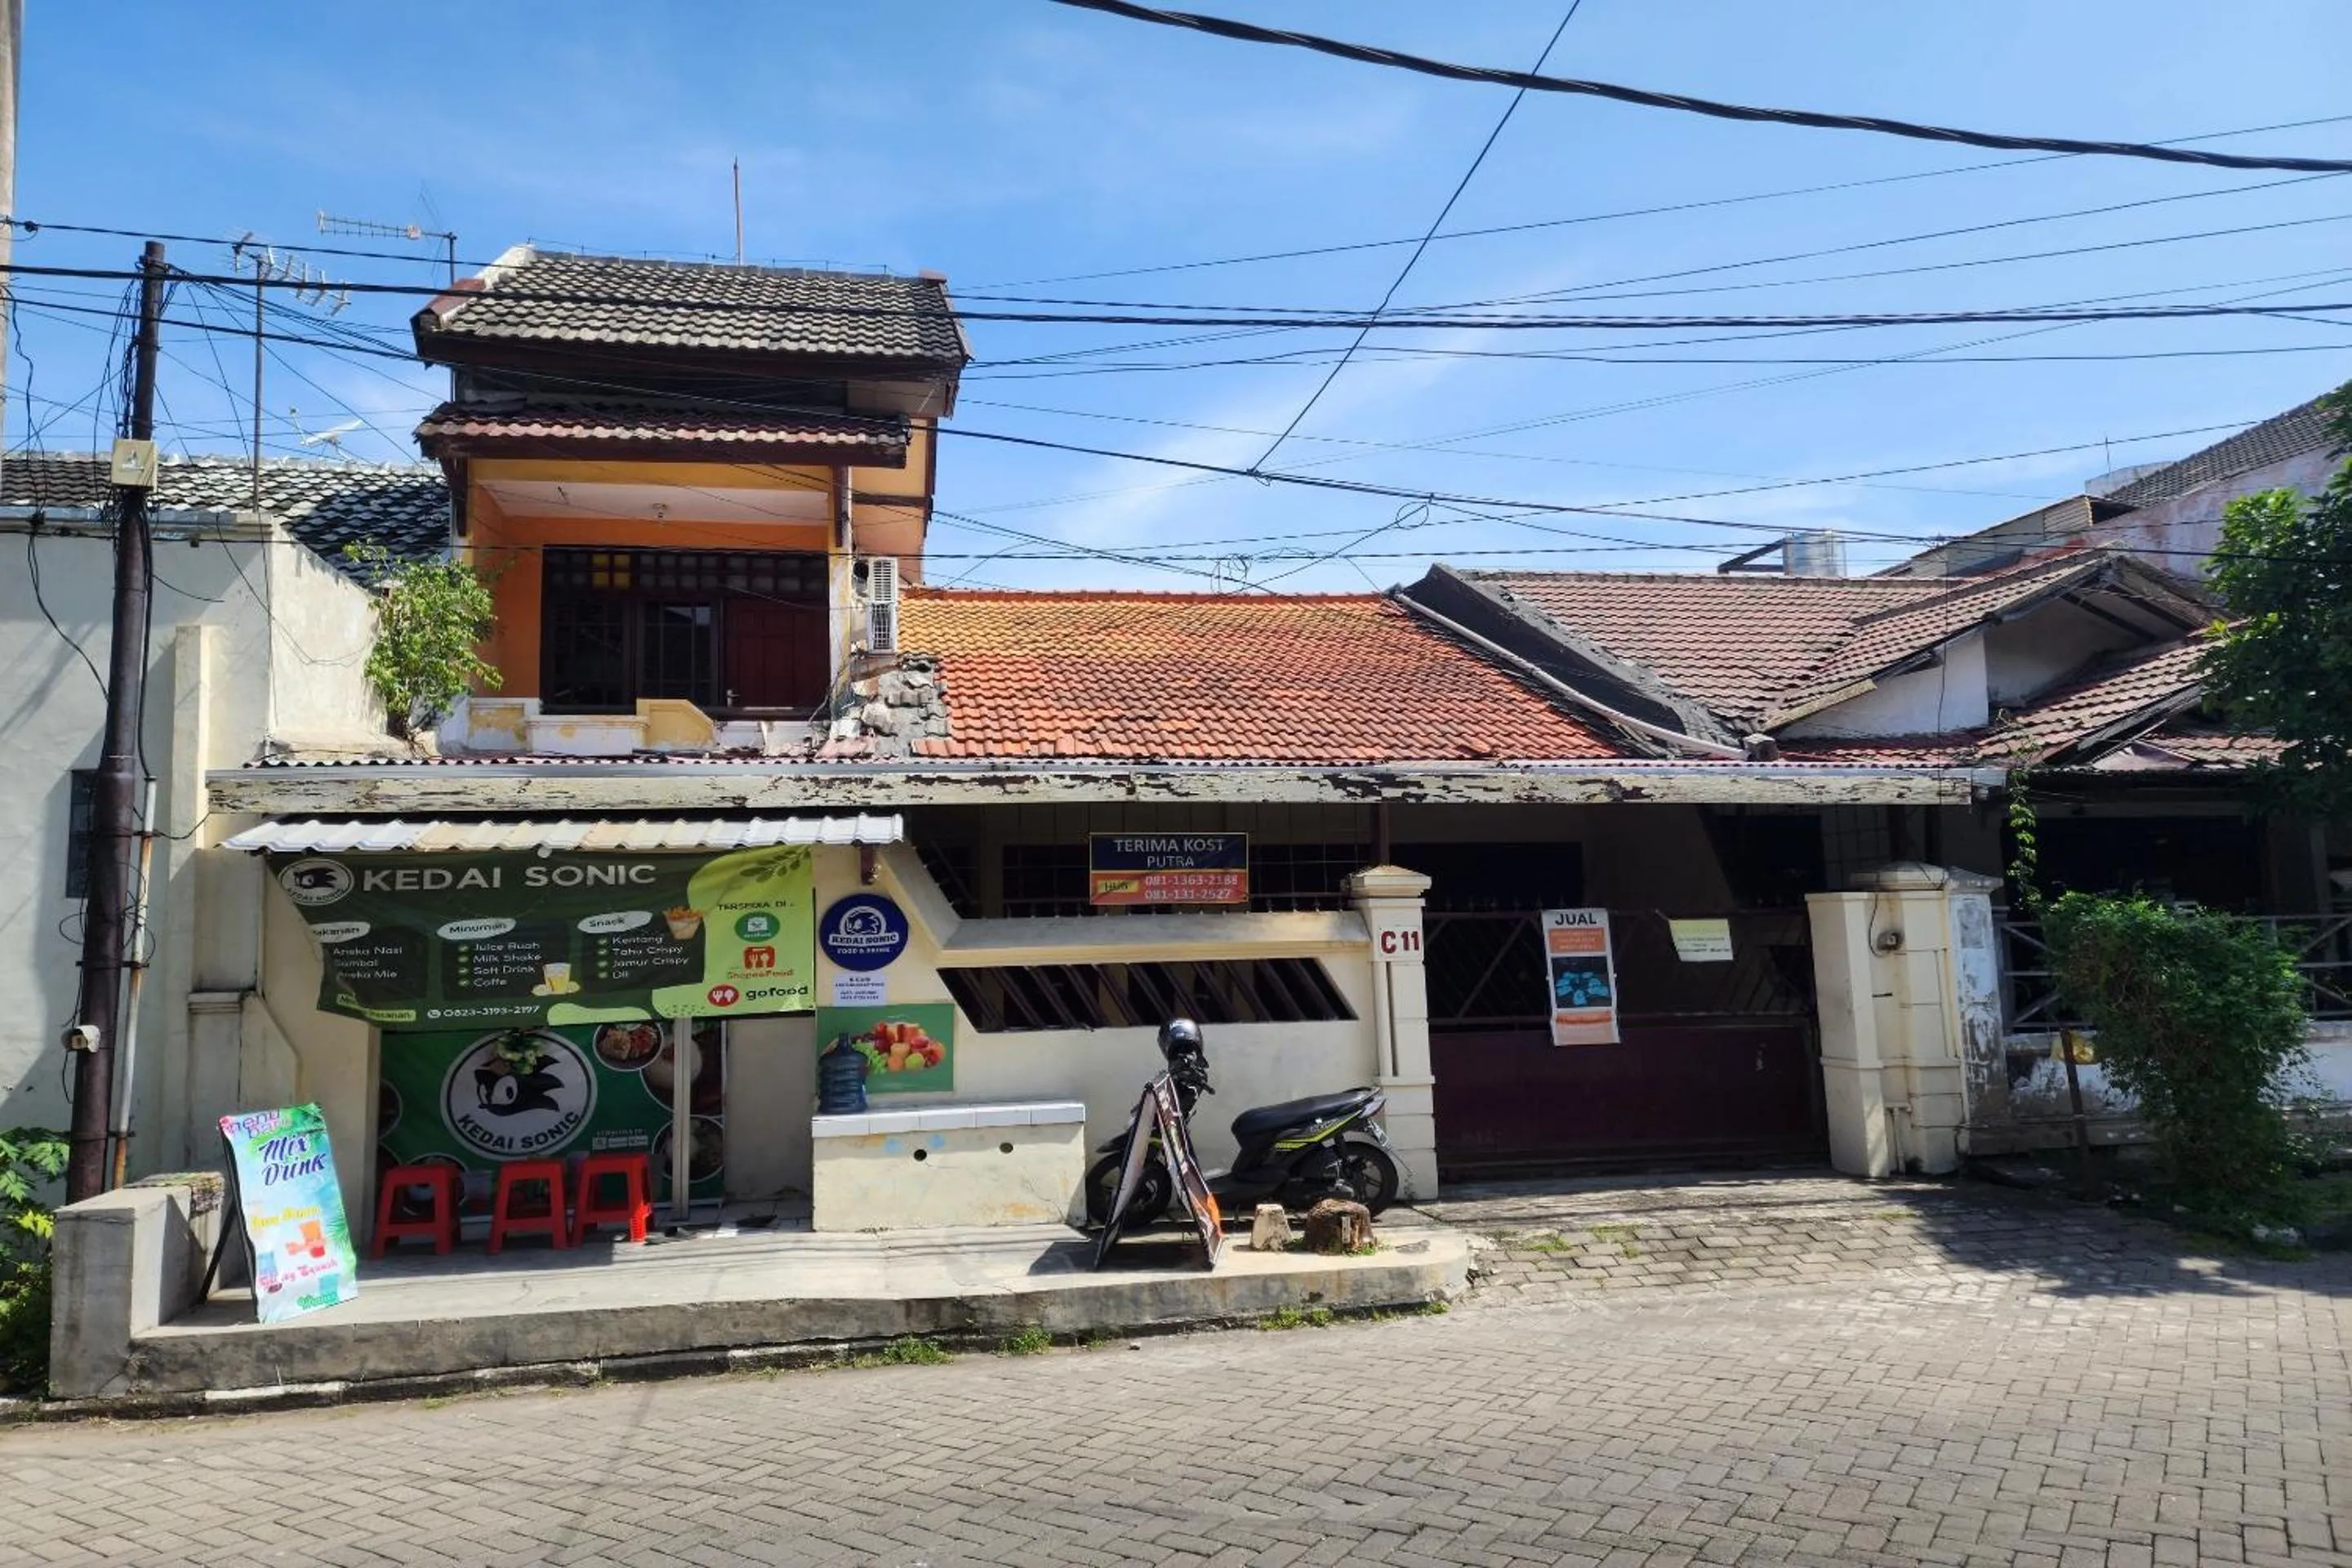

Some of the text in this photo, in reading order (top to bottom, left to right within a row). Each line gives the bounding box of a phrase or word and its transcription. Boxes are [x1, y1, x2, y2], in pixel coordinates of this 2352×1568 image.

[1113, 839, 1225, 852] TERIMA KOST
[1147, 856, 1195, 867] PUTRA
[363, 864, 657, 891] KEDAI SONIC
[589, 916, 626, 928] Snack
[1555, 912, 1597, 926] JUAL
[612, 936, 663, 945] Kentang
[374, 947, 403, 955] Nasi
[474, 943, 504, 951] Juice
[646, 946, 684, 955] Crispy
[474, 953, 542, 964] Milk Shake
[653, 957, 689, 965] Crispy
[375, 969, 398, 978] Mie
[474, 964, 536, 975] Soft Drink
[474, 978, 508, 987] Coffe
[746, 986, 808, 1001] gofood
[458, 1111, 579, 1149] KEDAI SONIC
[259, 1135, 307, 1163] Mix
[261, 1153, 327, 1186] Drink
